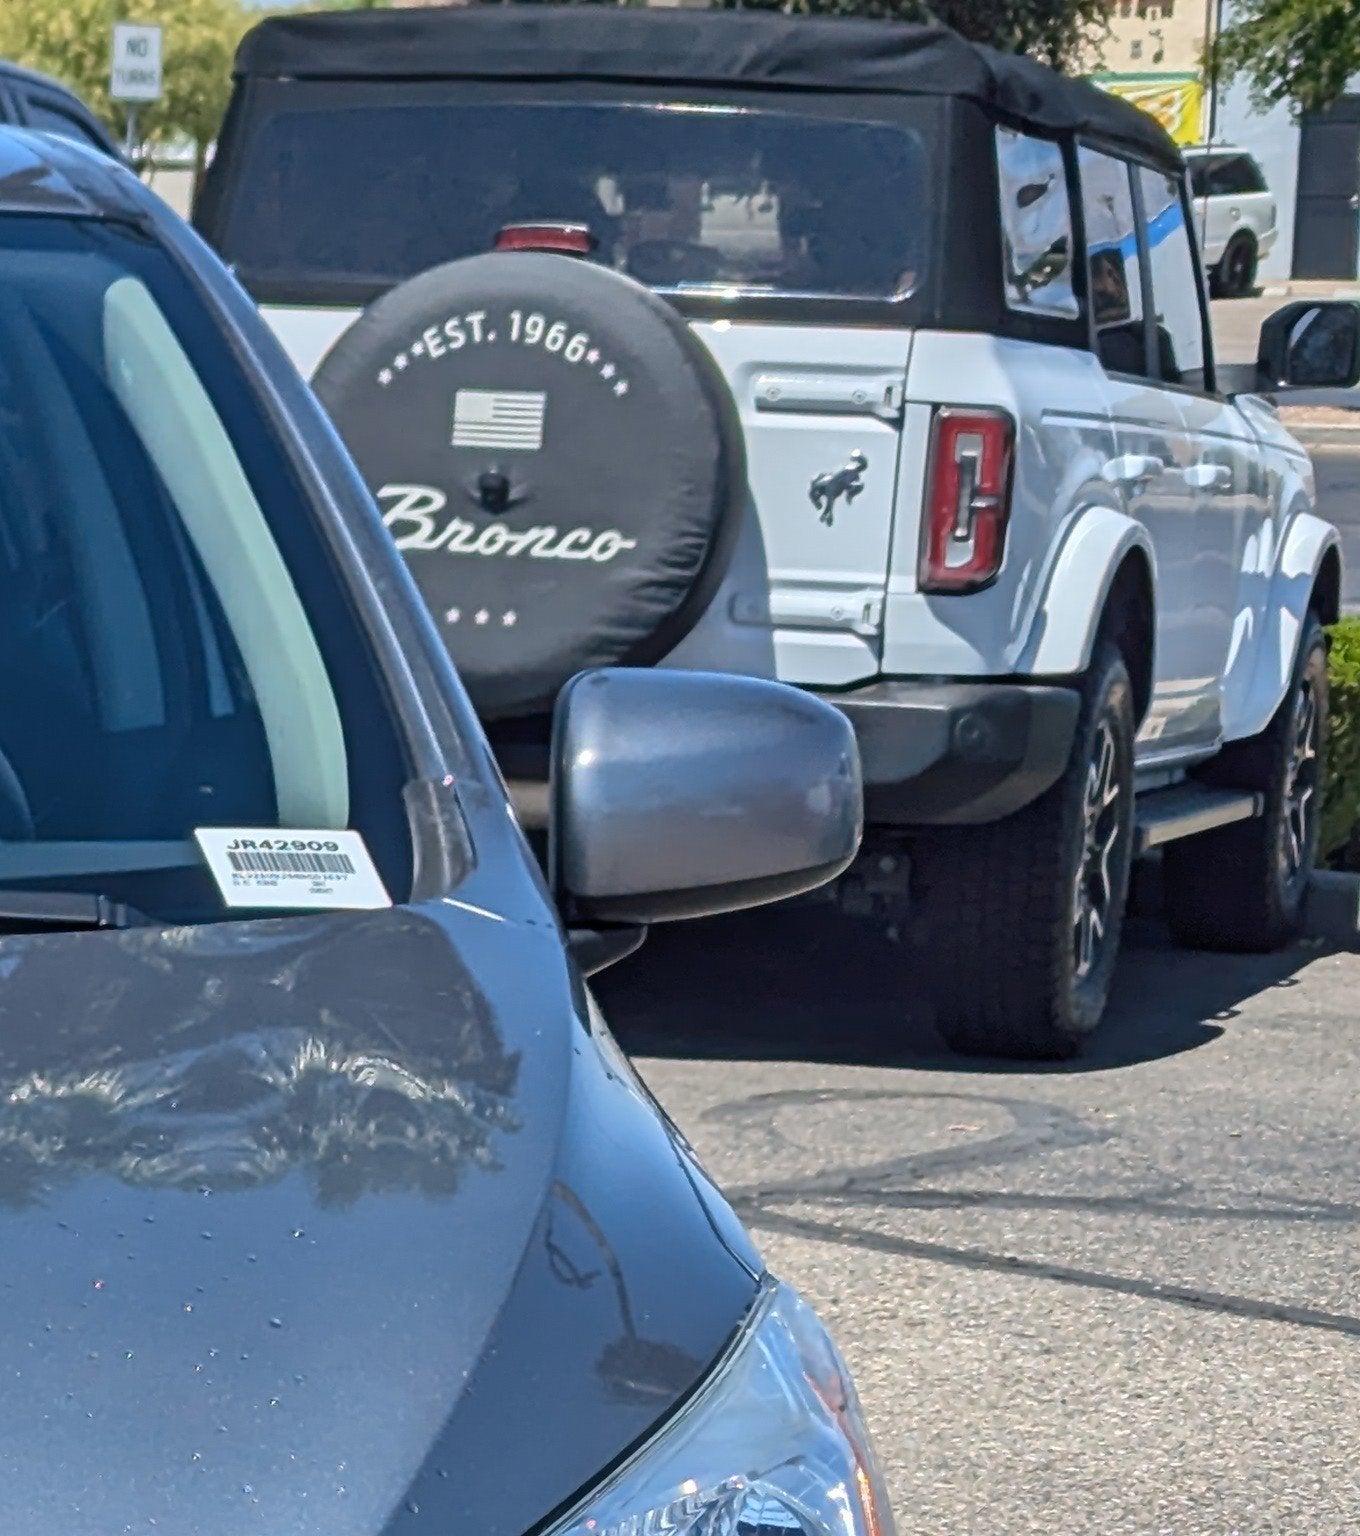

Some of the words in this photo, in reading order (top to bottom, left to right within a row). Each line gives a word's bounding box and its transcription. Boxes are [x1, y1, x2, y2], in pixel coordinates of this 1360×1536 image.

[423, 310, 497, 360] EST.
[508, 309, 588, 363] 1966
[376, 483, 638, 563] Bronco
